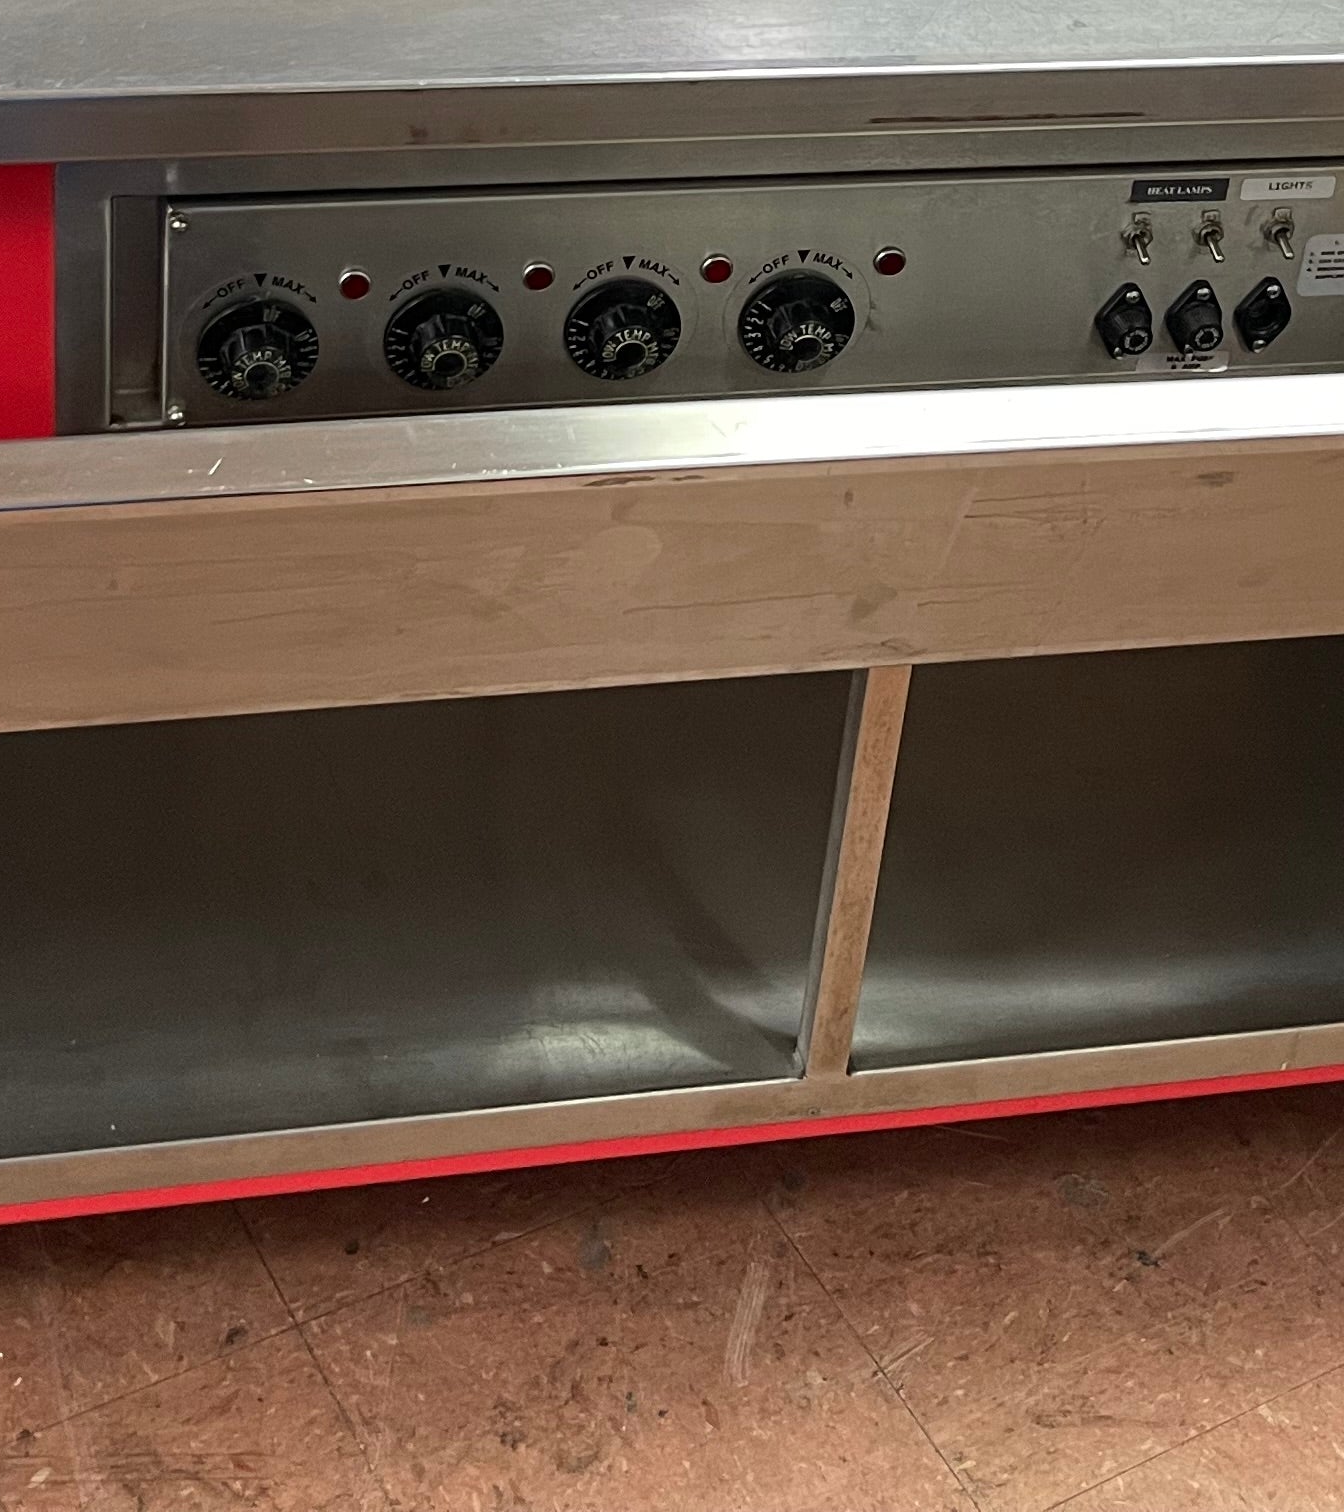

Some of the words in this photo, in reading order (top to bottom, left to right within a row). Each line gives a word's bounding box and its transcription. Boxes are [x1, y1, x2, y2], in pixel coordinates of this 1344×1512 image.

[1146, 185, 1176, 196] HEAT
[1177, 185, 1213, 196] LAMPS
[1268, 180, 1313, 192] LIGHTS
[586, 260, 614, 280] OFF
[638, 258, 669, 278] MAX
[762, 254, 790, 274] OFF
[812, 252, 843, 271] MAX
[216, 278, 247, 298] OFF
[271, 276, 306, 295] MAX
[402, 269, 430, 291] OFF
[455, 266, 488, 285] MAX
[615, 328, 652, 344] TEMP
[798, 323, 832, 340] TEMP
[432, 338, 471, 353] TEMP
[234, 349, 274, 369] TEMP
